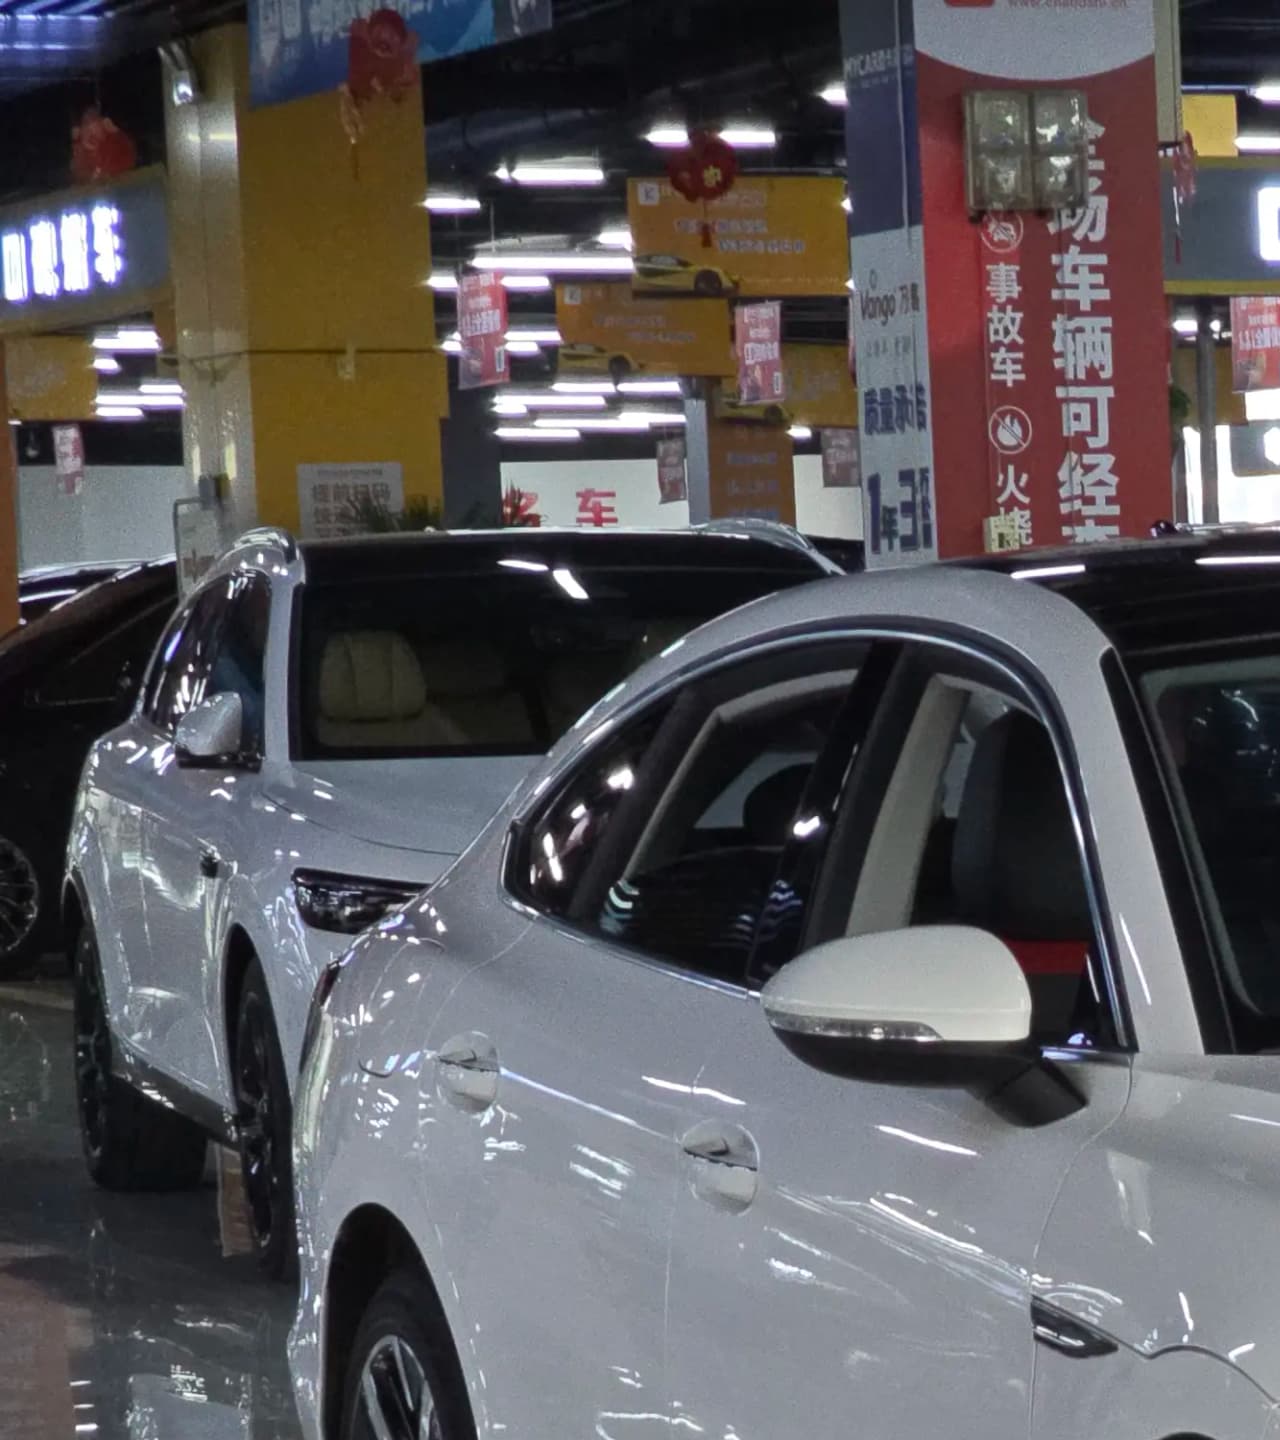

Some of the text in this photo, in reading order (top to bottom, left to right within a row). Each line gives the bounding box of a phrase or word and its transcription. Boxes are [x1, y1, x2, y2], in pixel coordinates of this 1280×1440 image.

[985, 263, 1027, 388] 事故车
[1045, 118, 1122, 543] 场车辆可经
